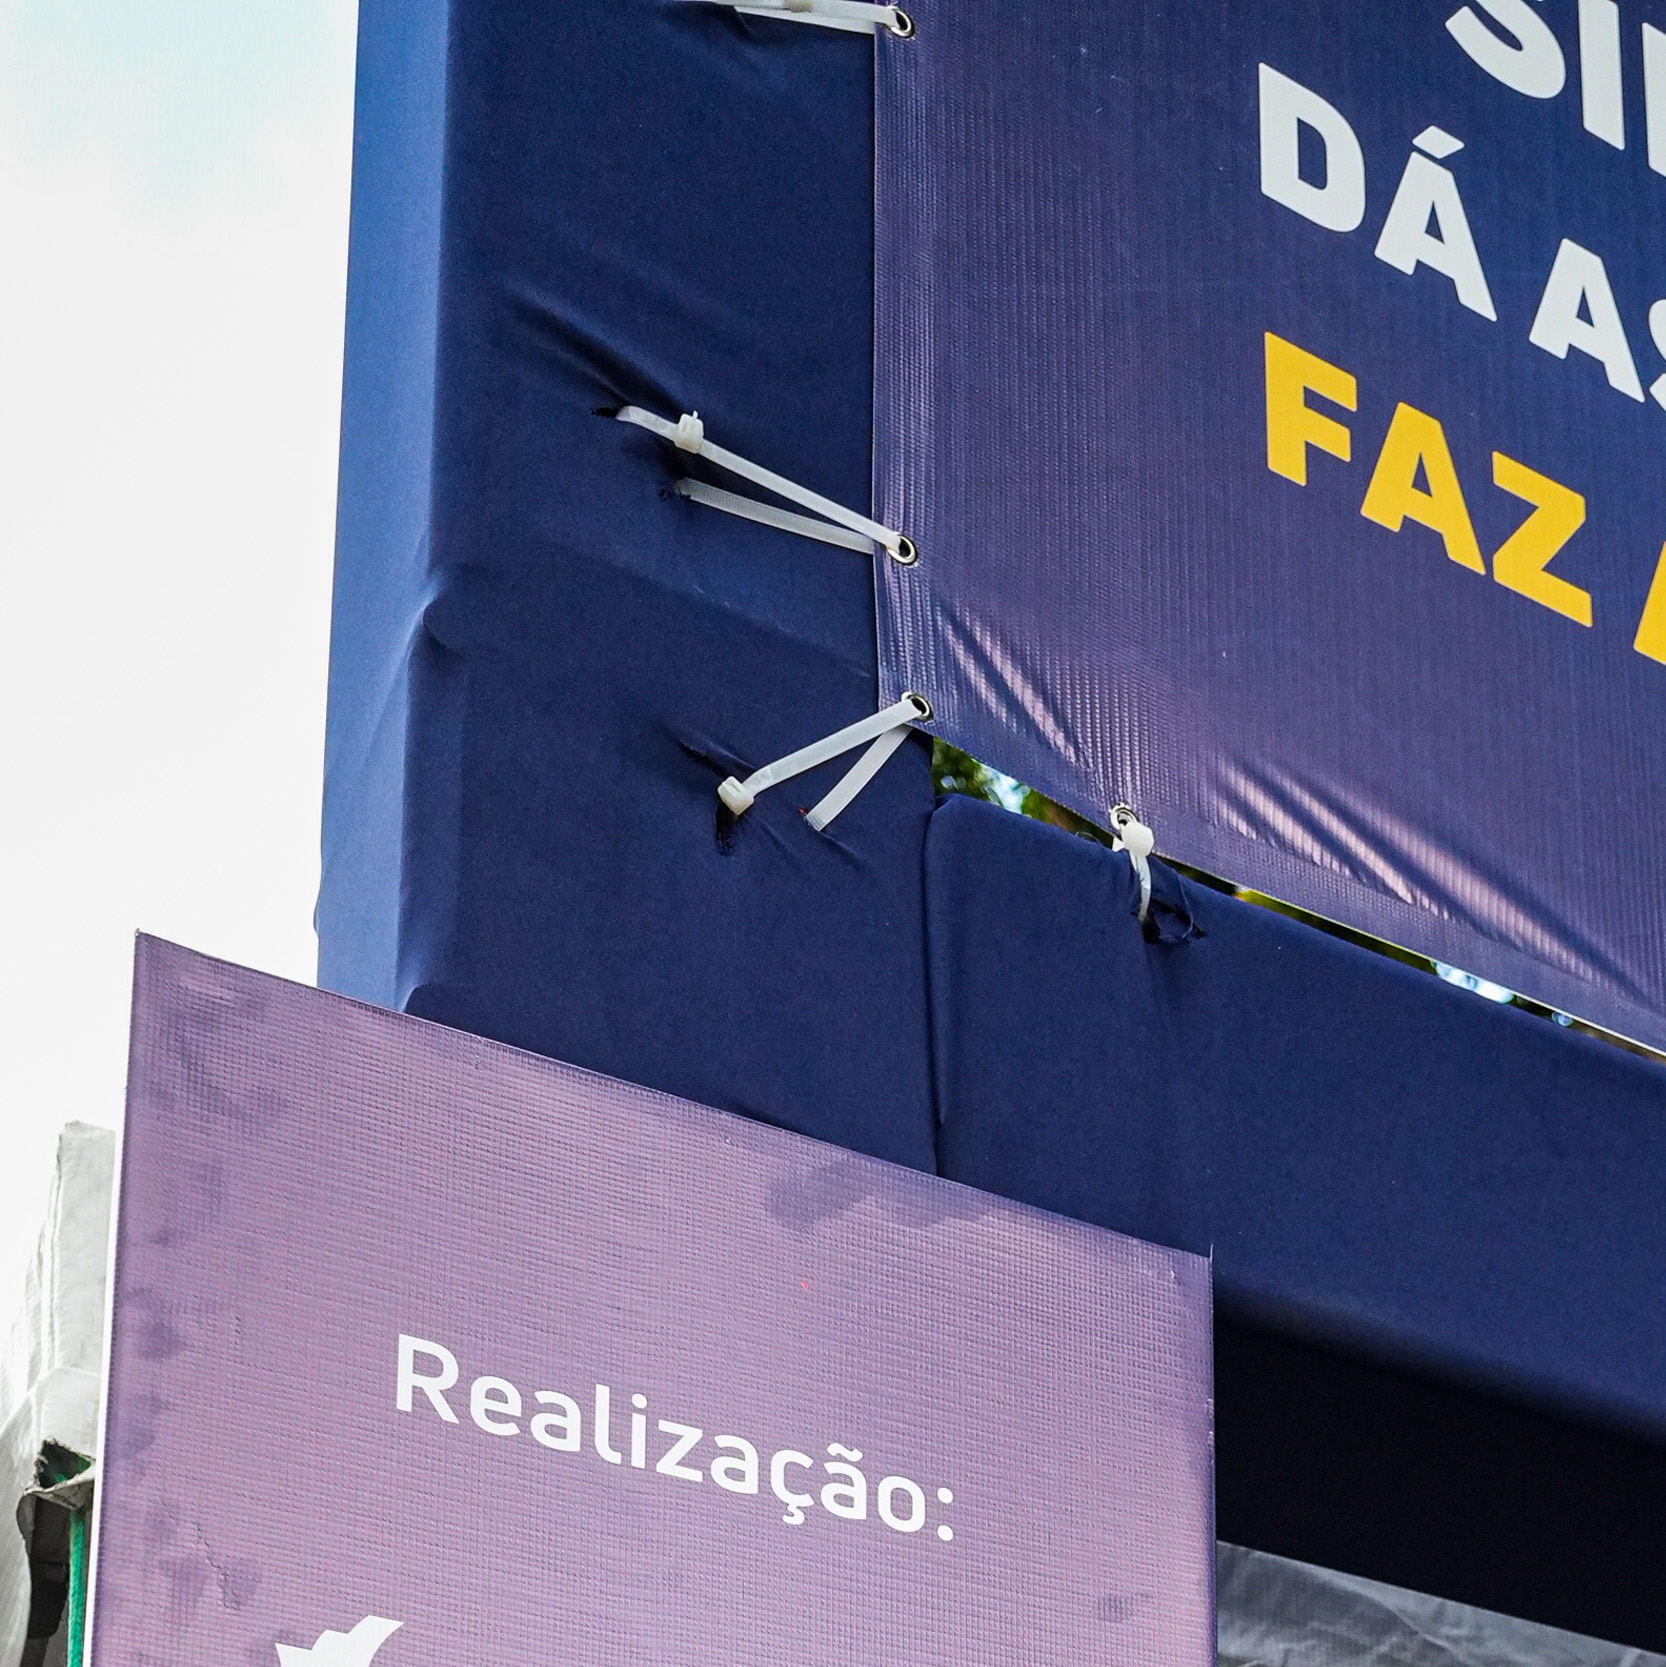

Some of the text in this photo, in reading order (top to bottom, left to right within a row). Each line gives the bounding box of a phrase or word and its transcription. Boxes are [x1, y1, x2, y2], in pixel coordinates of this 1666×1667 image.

[1258, 62, 1498, 322] DÁ
[1264, 331, 1593, 626] FAZ
[396, 1333, 954, 1542] Realização:
